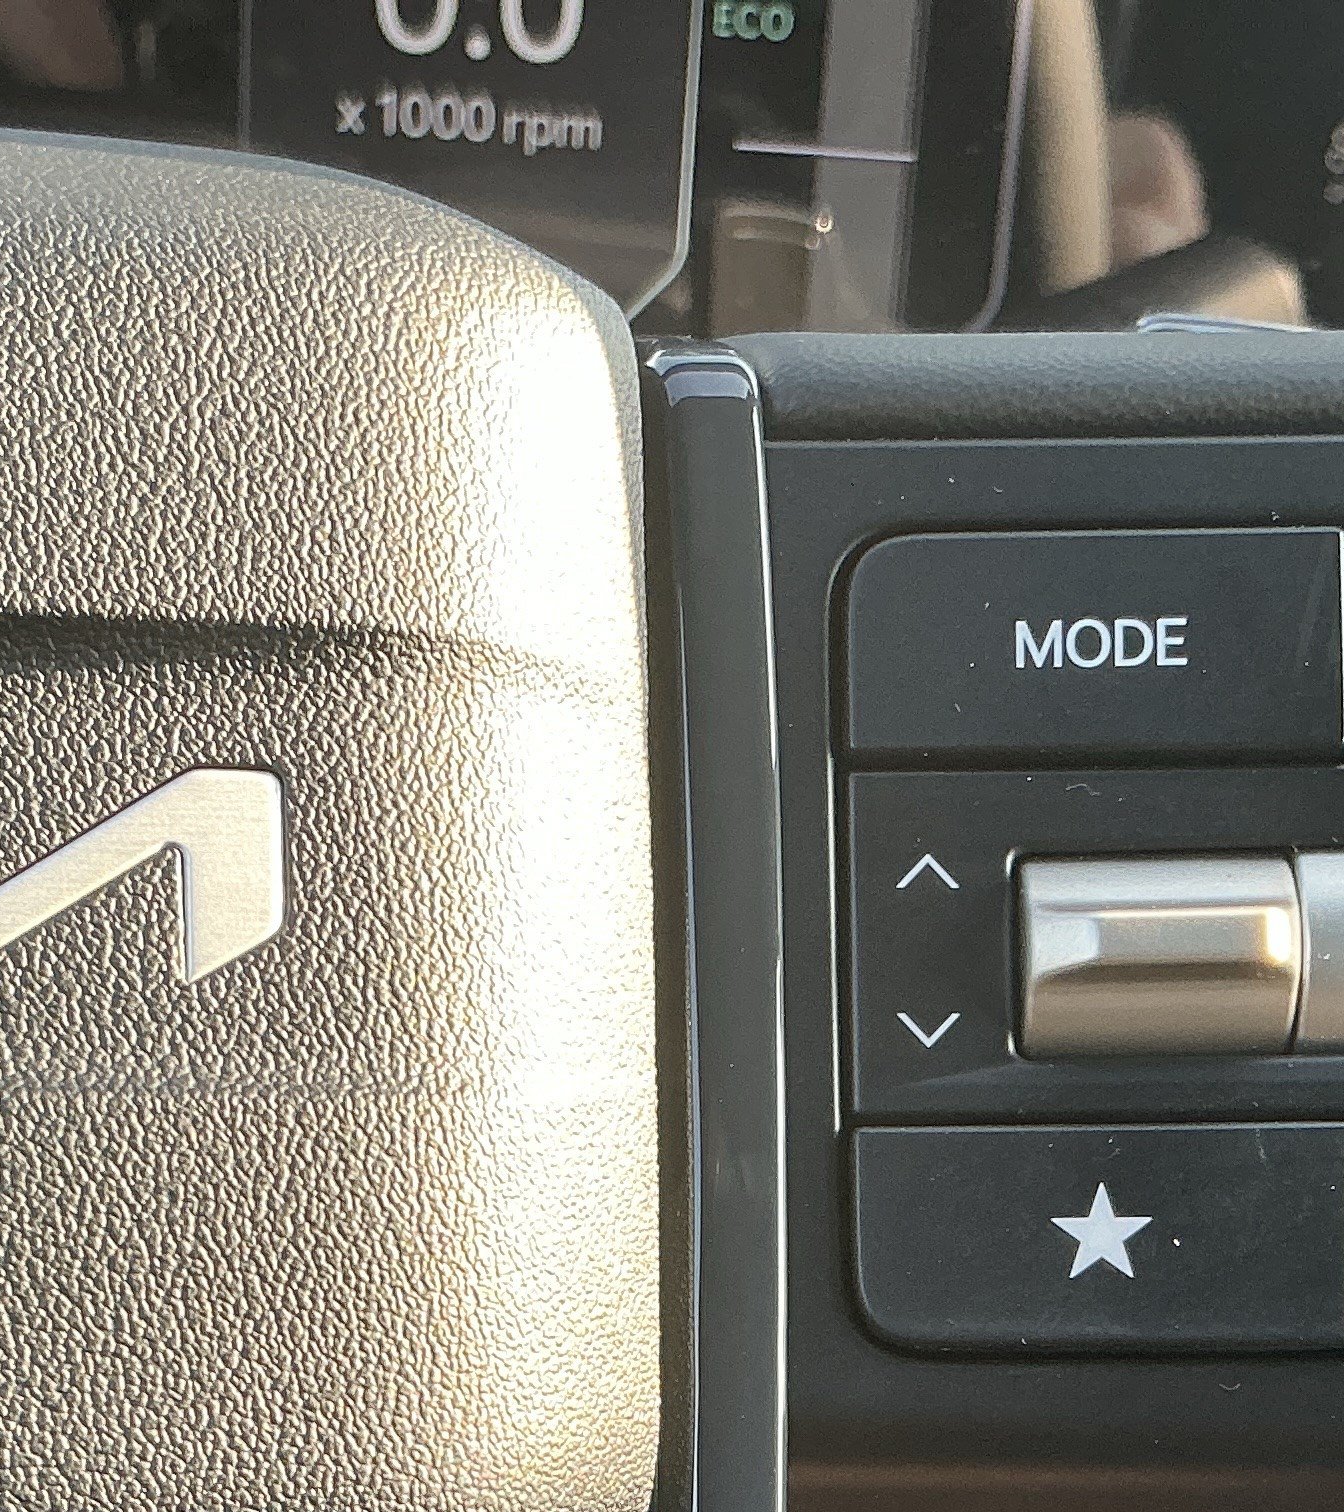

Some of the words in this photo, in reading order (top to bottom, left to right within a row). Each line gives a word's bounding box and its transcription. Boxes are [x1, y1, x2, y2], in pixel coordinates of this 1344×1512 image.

[712, 2, 794, 41] ECO
[375, 88, 496, 142] 1000
[502, 108, 603, 156] rpm
[1015, 617, 1188, 669] MODE
